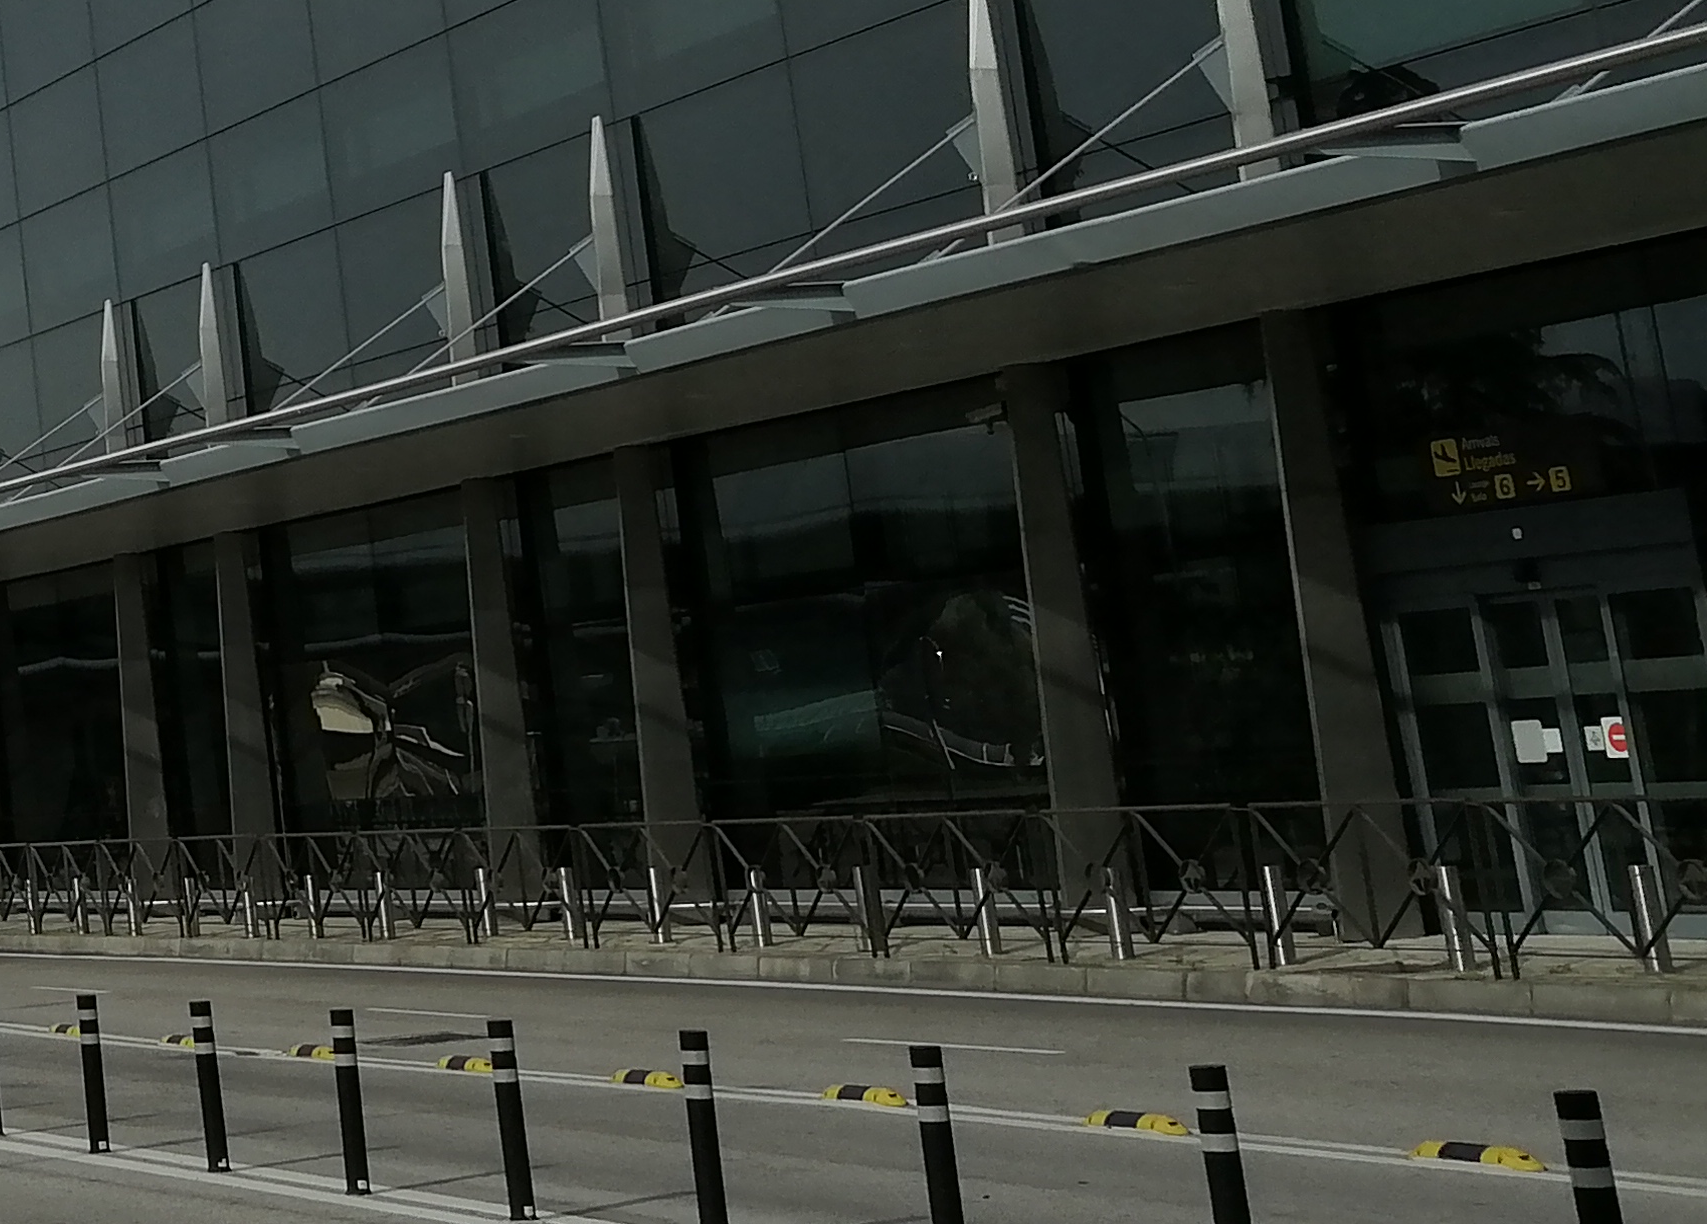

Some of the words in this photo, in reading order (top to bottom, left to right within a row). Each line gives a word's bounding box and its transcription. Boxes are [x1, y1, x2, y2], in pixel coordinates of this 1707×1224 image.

[1462, 435, 1500, 450] Arrivals
[1464, 451, 1516, 471] Llegadas
[1499, 477, 1511, 495] 6
[1555, 470, 1566, 488] 5
